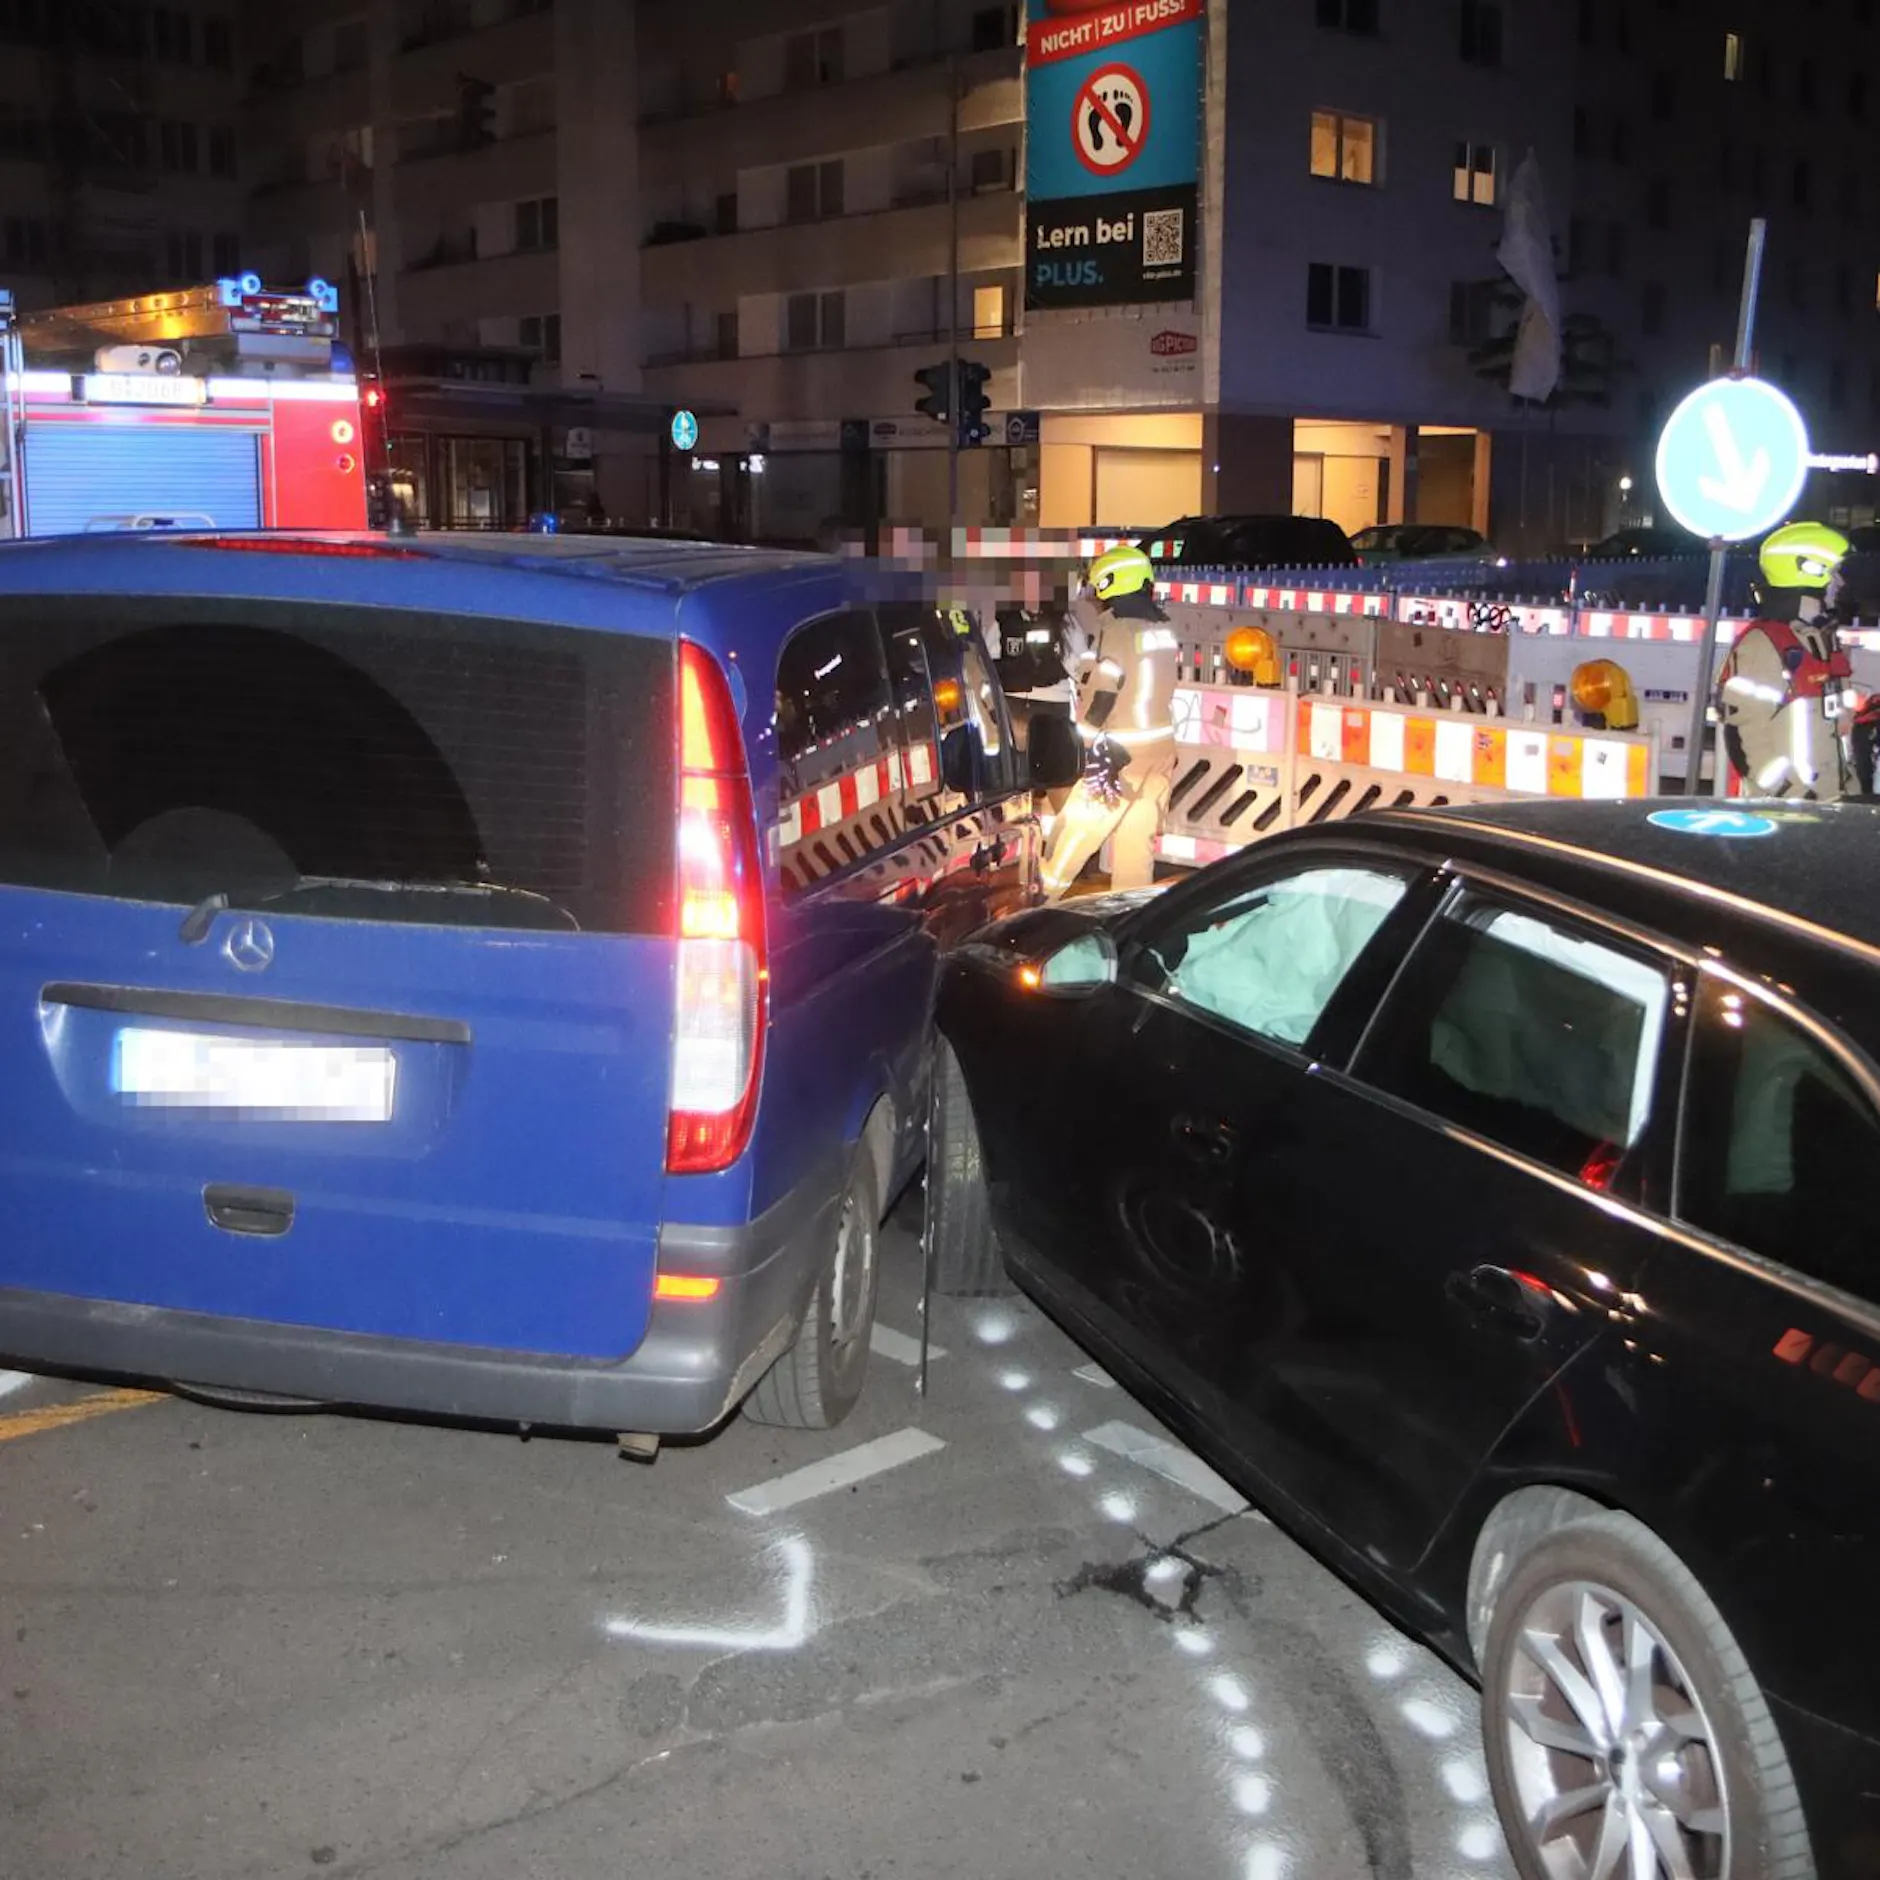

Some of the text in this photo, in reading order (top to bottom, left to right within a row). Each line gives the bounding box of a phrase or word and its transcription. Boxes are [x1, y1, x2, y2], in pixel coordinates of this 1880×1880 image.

[1041, 0, 1186, 54] NICHT ZU FUSS!
[1036, 212, 1135, 250] Lern bei
[1035, 260, 1105, 288] PLUS.
